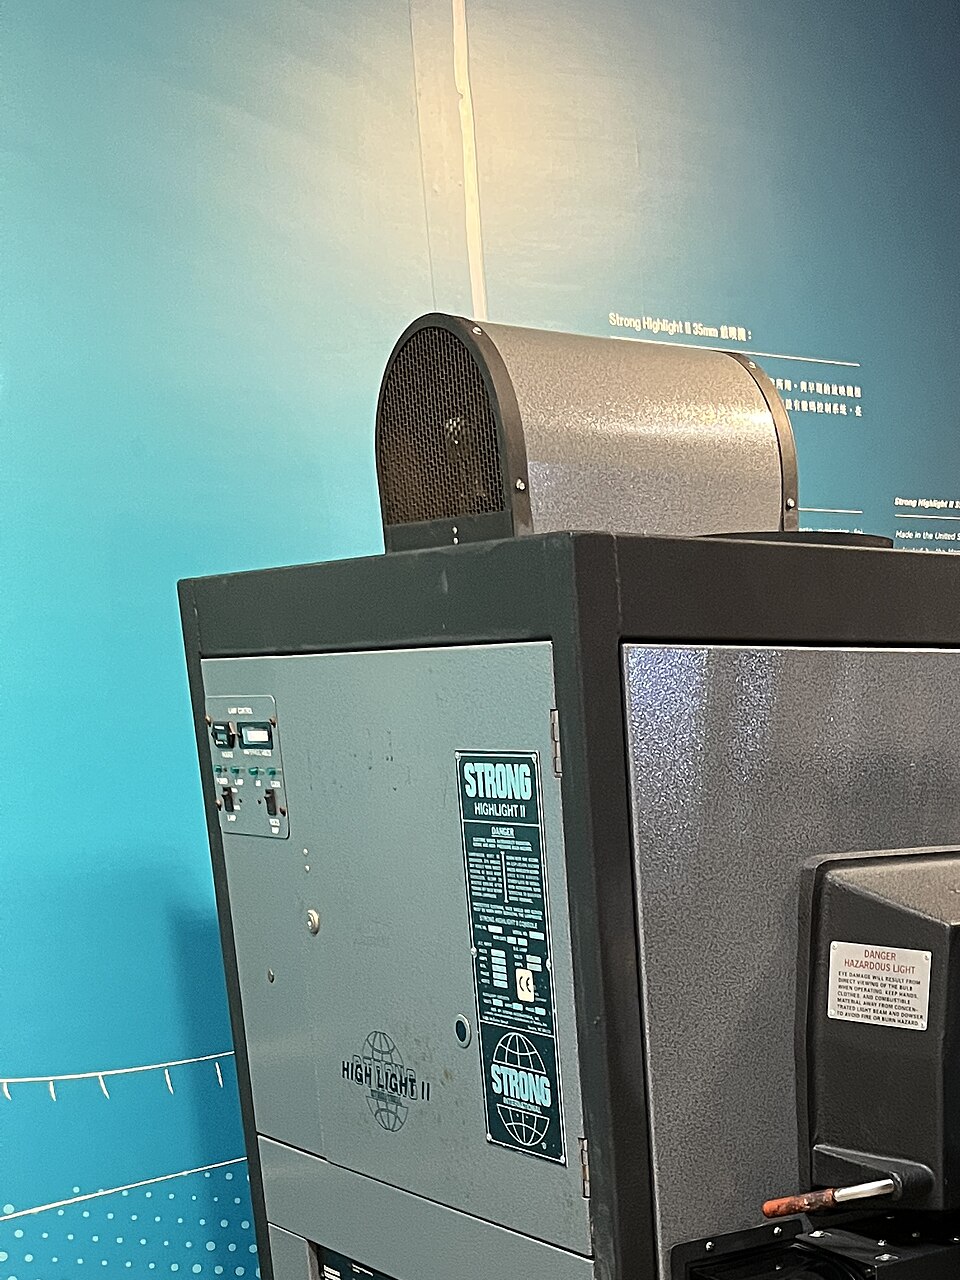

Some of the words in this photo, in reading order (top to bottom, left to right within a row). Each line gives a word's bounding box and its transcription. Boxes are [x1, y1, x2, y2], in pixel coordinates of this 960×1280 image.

[608, 312, 641, 331] Strong
[642, 316, 683, 335] Highlight
[692, 322, 718, 337] 35mm
[894, 497, 917, 508] Strong
[918, 499, 948, 510] Highlight
[895, 530, 914, 539] Made
[914, 531, 921, 539] in
[922, 531, 934, 540] the
[935, 532, 956, 541] United
[463, 762, 532, 800] STRONG
[474, 802, 519, 818] HIGHLIGHT
[519, 804, 526, 818] II
[491, 826, 515, 837] DANGER
[864, 949, 896, 961] DANGER
[844, 959, 891, 972] HAZARDOUS
[892, 965, 916, 975] LIGHT
[848, 972, 871, 980] DAMAGE
[885, 976, 905, 984] RESULT
[857, 980, 879, 988] VIEWING
[837, 998, 861, 1006] MATERIAL
[874, 995, 911, 1005] COMBUSTIBLE
[900, 1012, 924, 1020] DOWSER
[421, 1081, 430, 1101] II
[491, 1063, 552, 1108] STRONG
